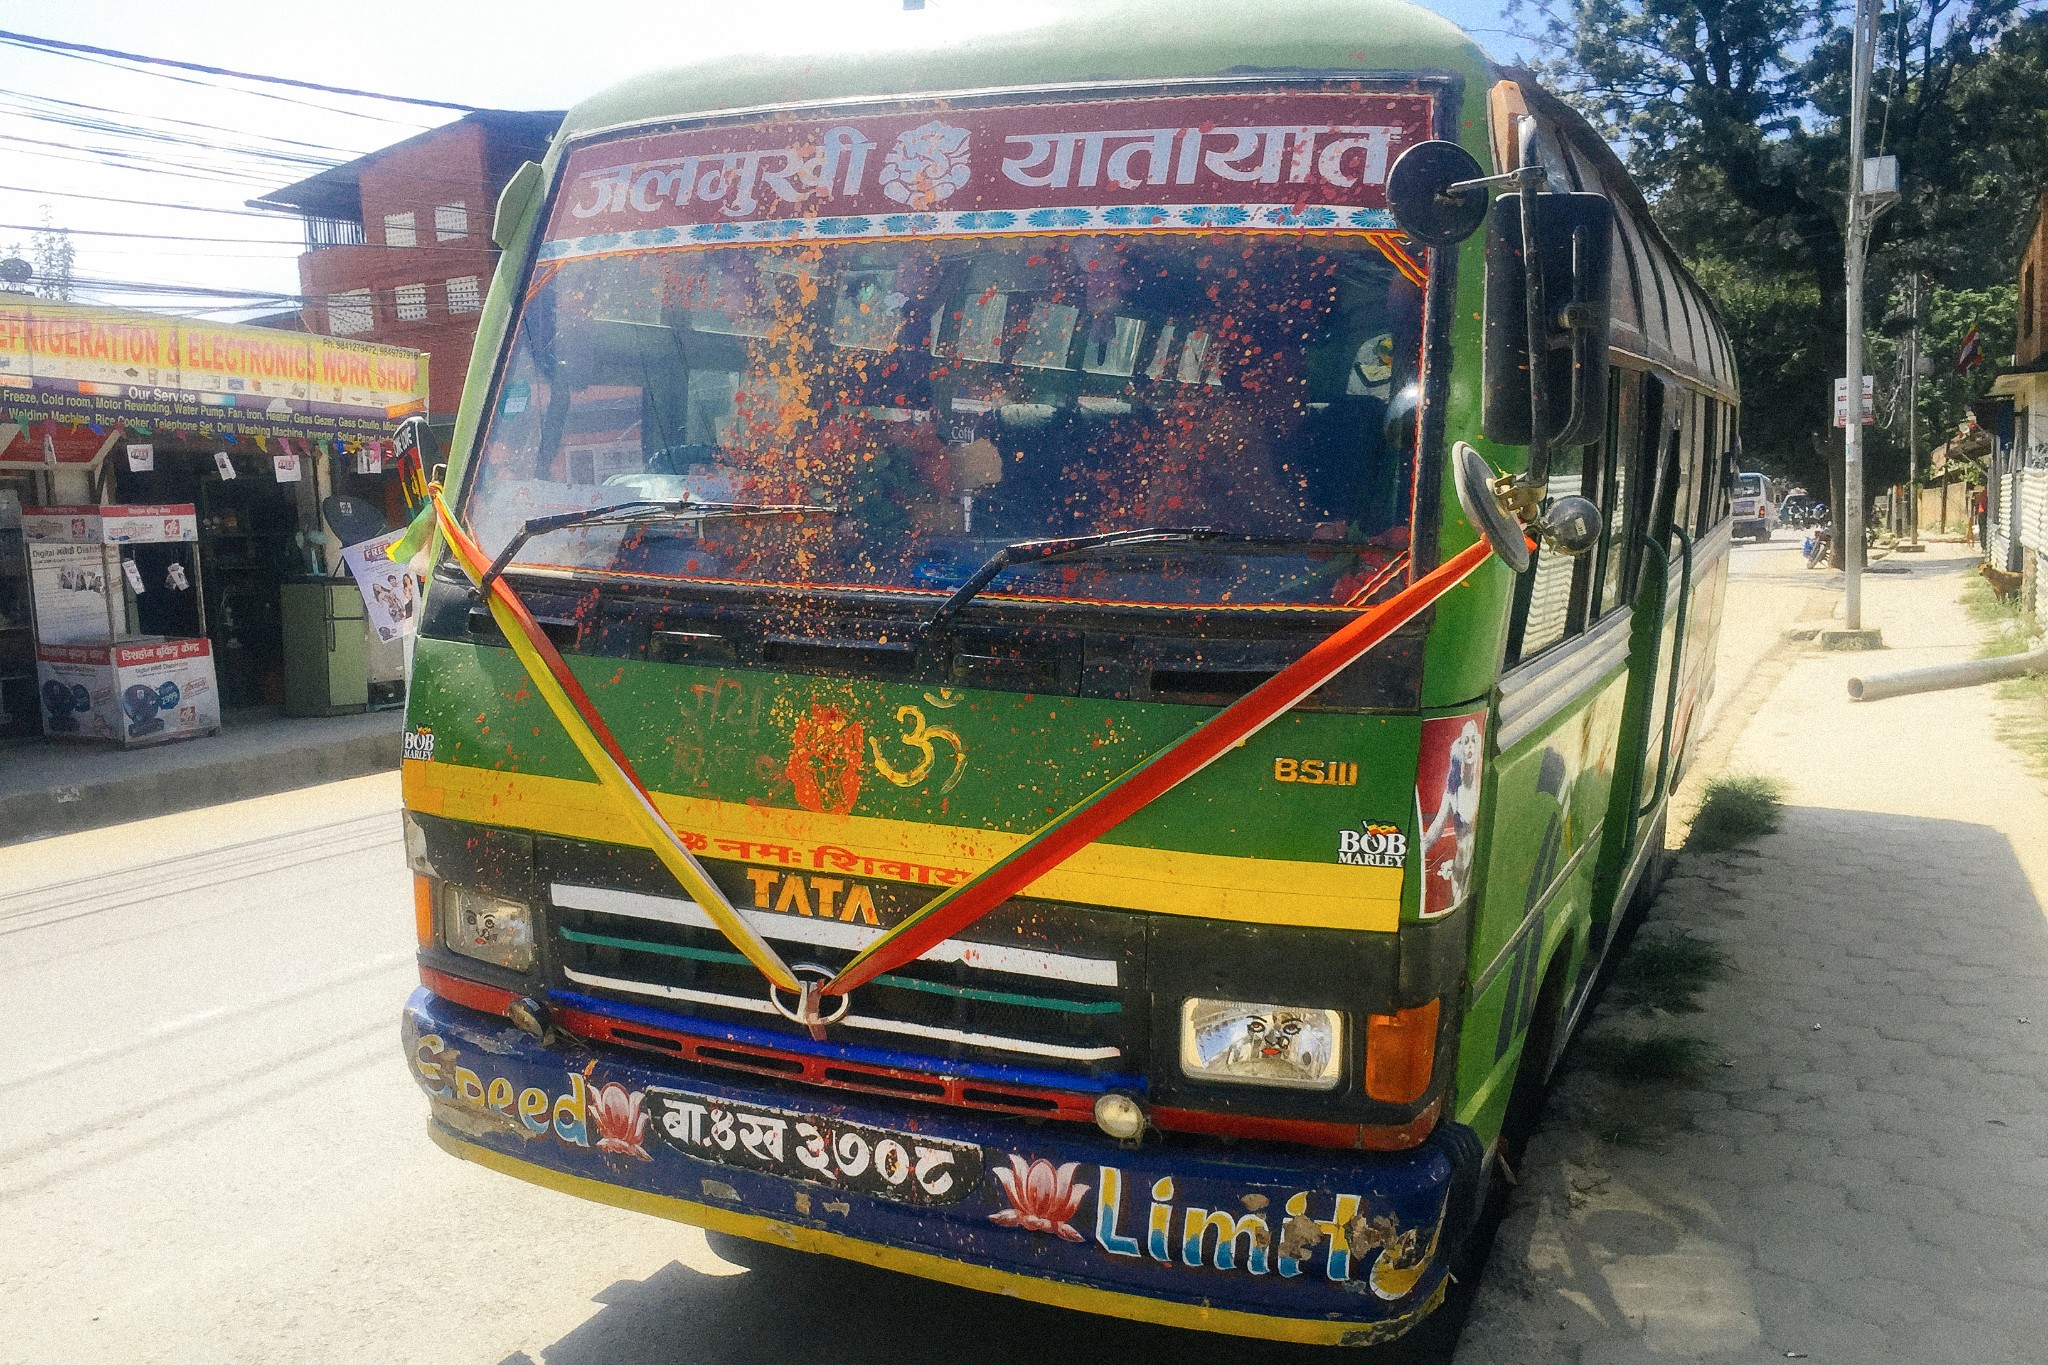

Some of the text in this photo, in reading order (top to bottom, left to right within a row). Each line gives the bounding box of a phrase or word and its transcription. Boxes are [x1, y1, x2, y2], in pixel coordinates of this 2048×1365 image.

[1001, 126, 1402, 189] यातायात
[167, 331, 180, 366] &
[188, 332, 317, 380] ELECTRONICS
[323, 350, 371, 388] WORK
[377, 359, 419, 393] SHOP
[128, 385, 195, 404] Our Service
[4, 390, 38, 405] Freeze,
[41, 393, 64, 406] Cold
[67, 395, 94, 409] room,
[96, 398, 121, 410] Motor
[125, 400, 172, 416] Rewinding,
[174, 403, 199, 415] Water
[228, 408, 246, 420] Fan,
[294, 412, 313, 424] Gass
[339, 417, 356, 428] Gass
[95, 413, 116, 426] Rice
[154, 418, 198, 432] Telephone
[238, 424, 270, 438] Washing
[403, 749, 433, 761] MARLEY
[405, 731, 434, 751] BOB
[1338, 829, 1407, 857] BOB
[714, 838, 802, 864] नमः
[809, 844, 974, 886] शिवाय
[1338, 852, 1405, 868] MARLEY
[747, 867, 880, 925] TATA
